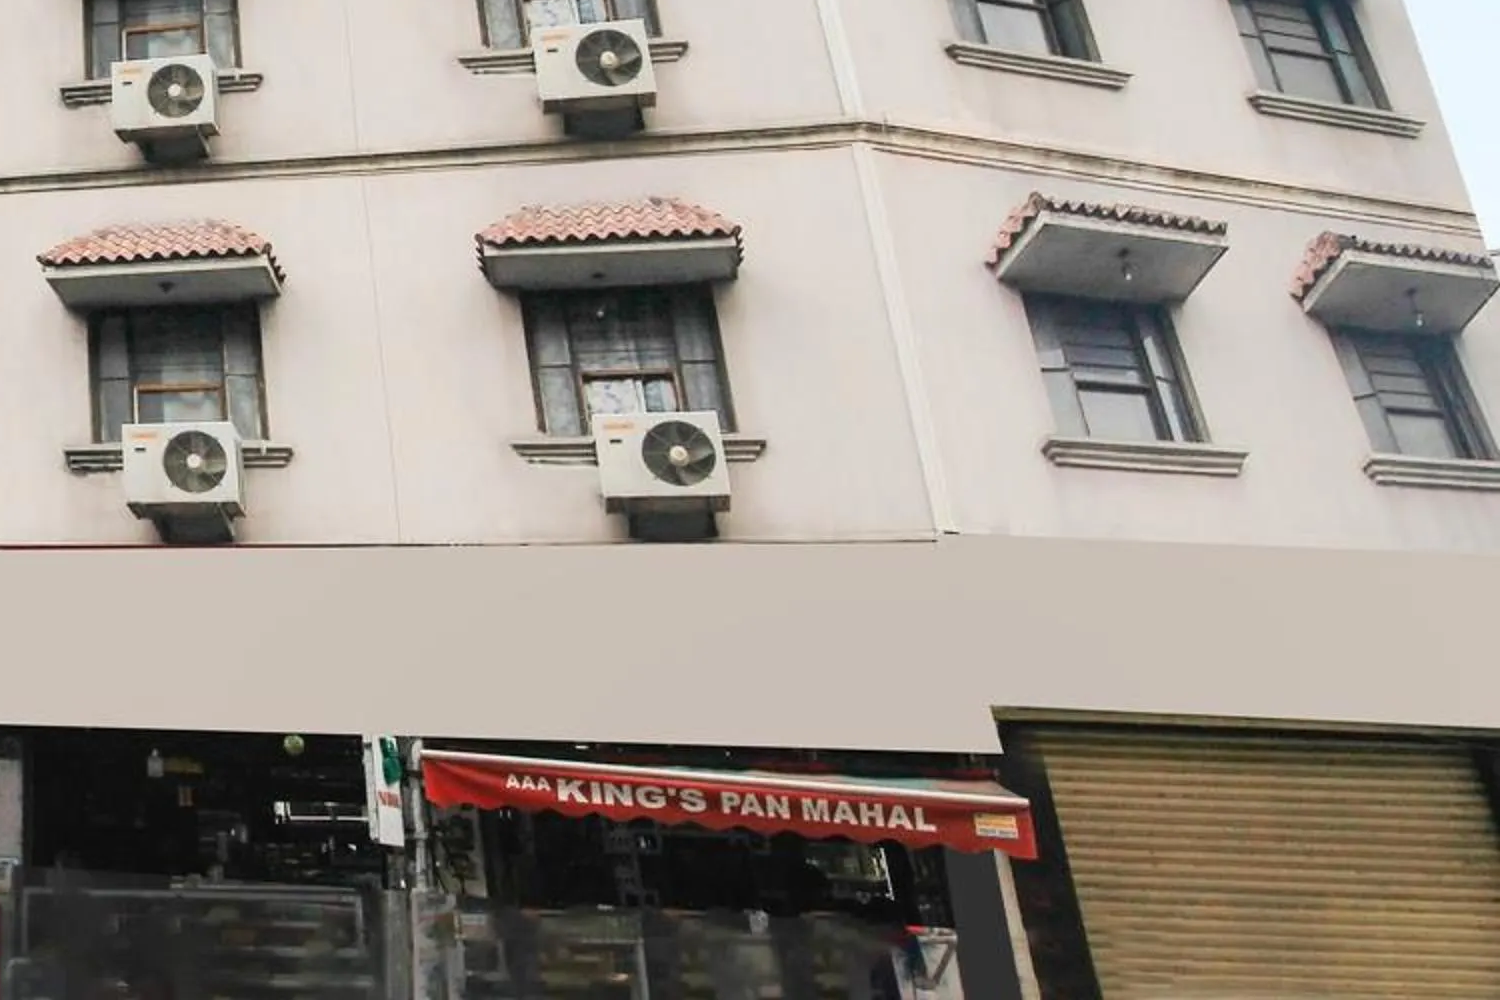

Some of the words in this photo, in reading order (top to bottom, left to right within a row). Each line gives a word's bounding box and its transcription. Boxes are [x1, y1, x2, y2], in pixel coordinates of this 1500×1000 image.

[505, 773, 552, 792] AAA
[556, 778, 708, 813] KING'S
[720, 791, 791, 820] PAN
[801, 797, 937, 833] MAHAL
